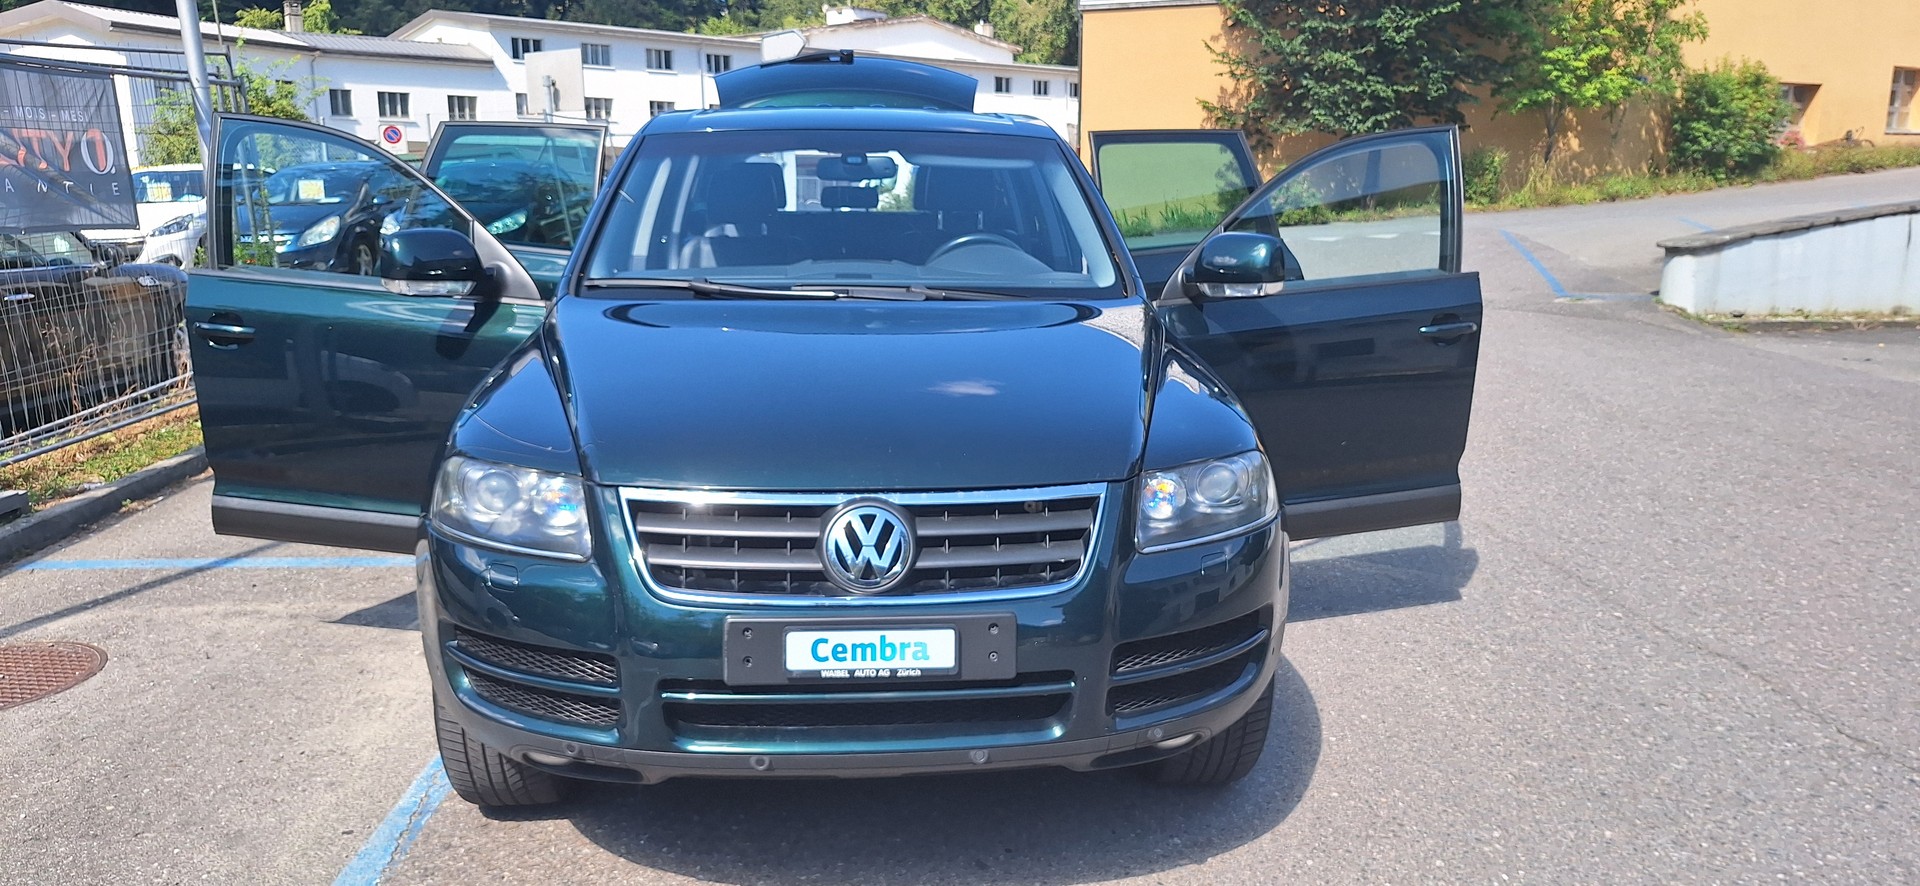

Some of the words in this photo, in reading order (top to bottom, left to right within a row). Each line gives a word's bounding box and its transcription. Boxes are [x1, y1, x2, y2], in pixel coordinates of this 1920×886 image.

[15, 106, 46, 120] MOIS
[5, 178, 120, 197] ANTIE
[826, 505, 910, 588] VW
[811, 634, 930, 662] Cembra
[821, 669, 850, 678] WAIBEL
[854, 669, 877, 678] AUTO
[878, 668, 891, 677] AG
[897, 668, 922, 677] Zürich
